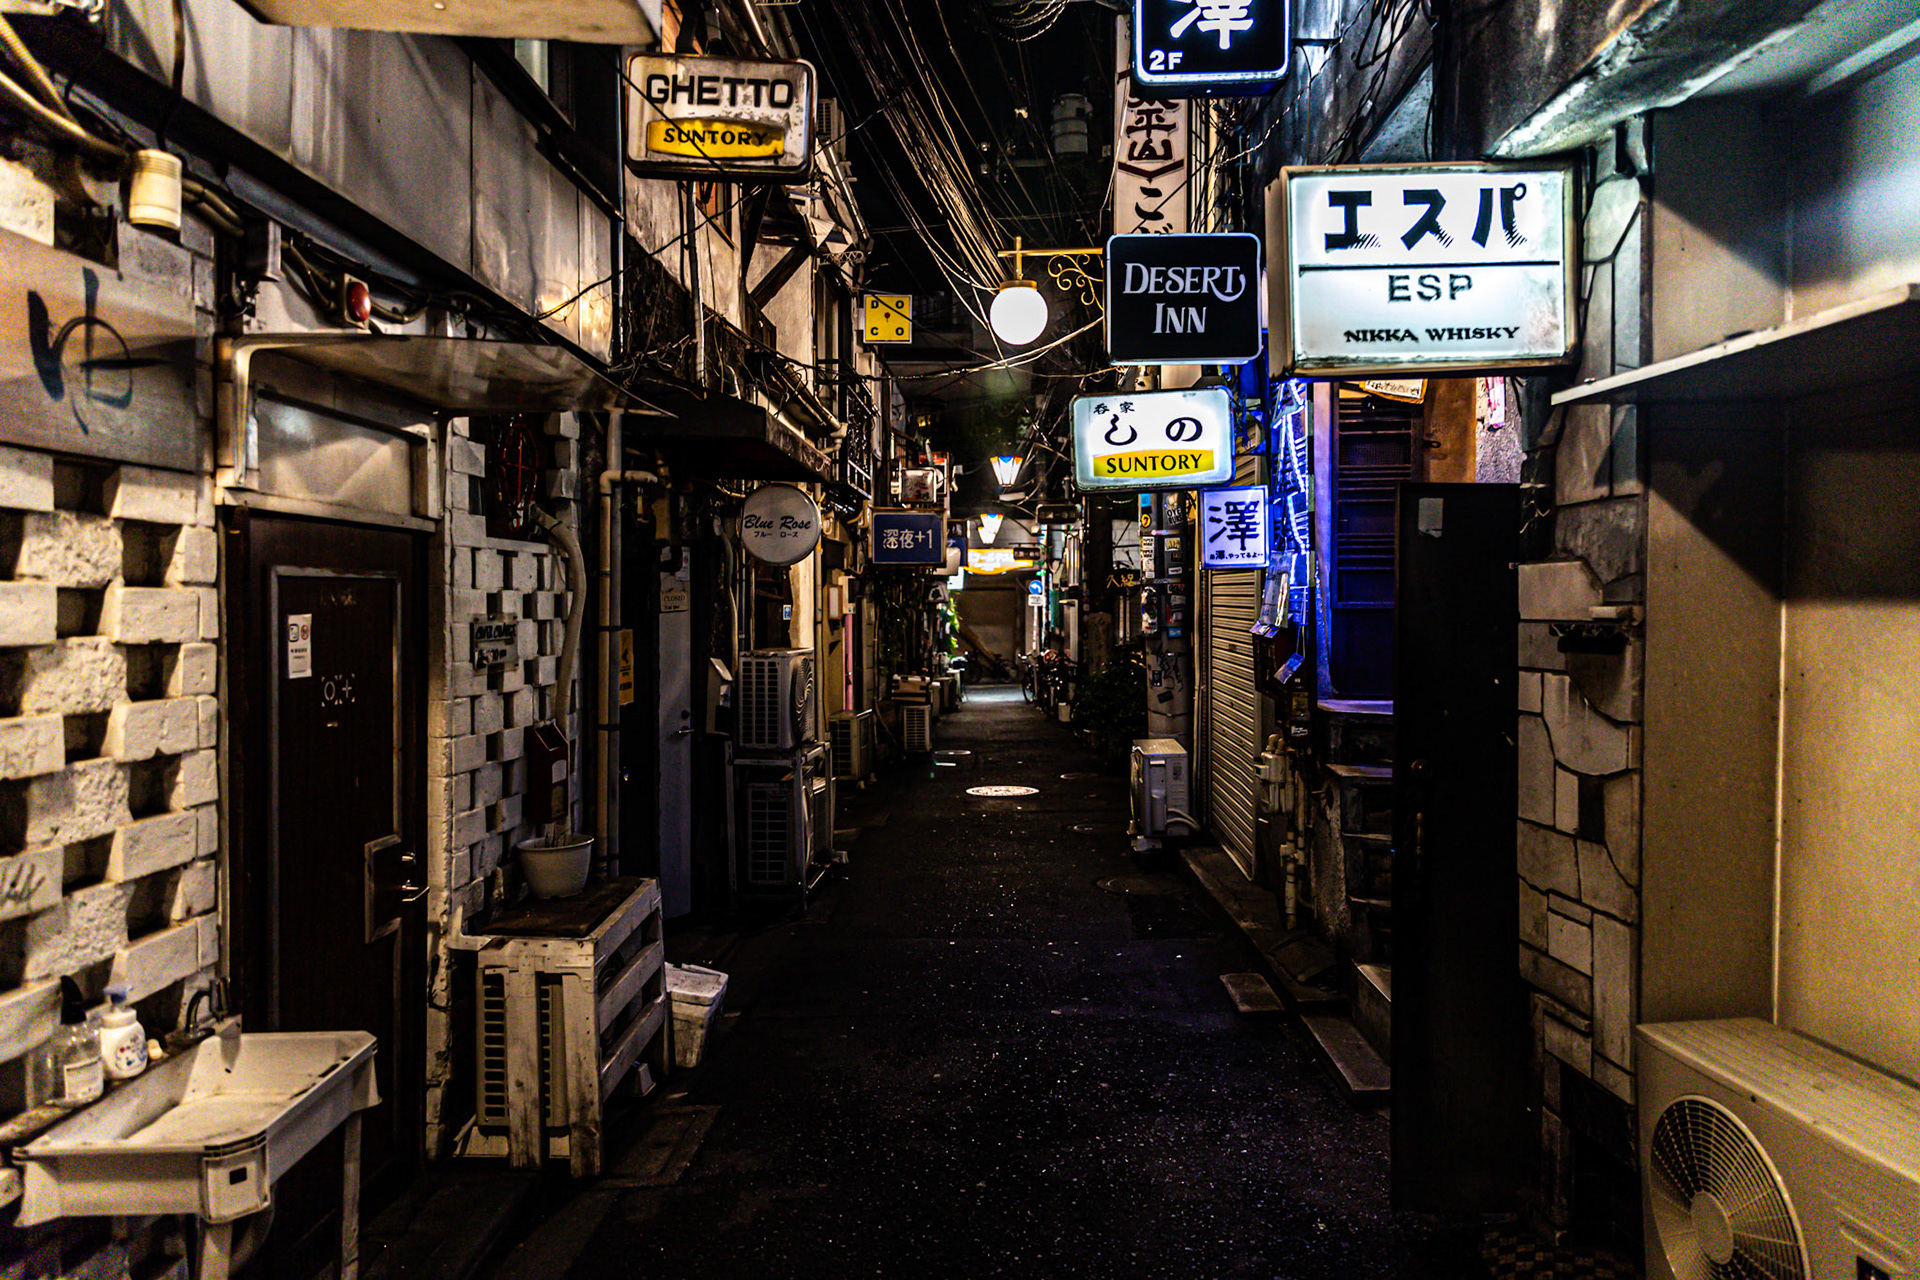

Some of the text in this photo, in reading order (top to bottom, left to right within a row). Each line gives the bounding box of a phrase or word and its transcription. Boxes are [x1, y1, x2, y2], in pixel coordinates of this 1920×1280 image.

[1149, 49, 1183, 71] 2F
[646, 74, 794, 109] GHETTO
[663, 128, 768, 147] SUNTORY
[1325, 182, 1528, 250] エスパ
[1387, 274, 1473, 303] ESP
[1345, 326, 1521, 343] NIKKA WHISKY
[1107, 453, 1202, 473] SUNTORY
[744, 514, 811, 530] Blue Rose
[1208, 500, 1260, 551] 澤
